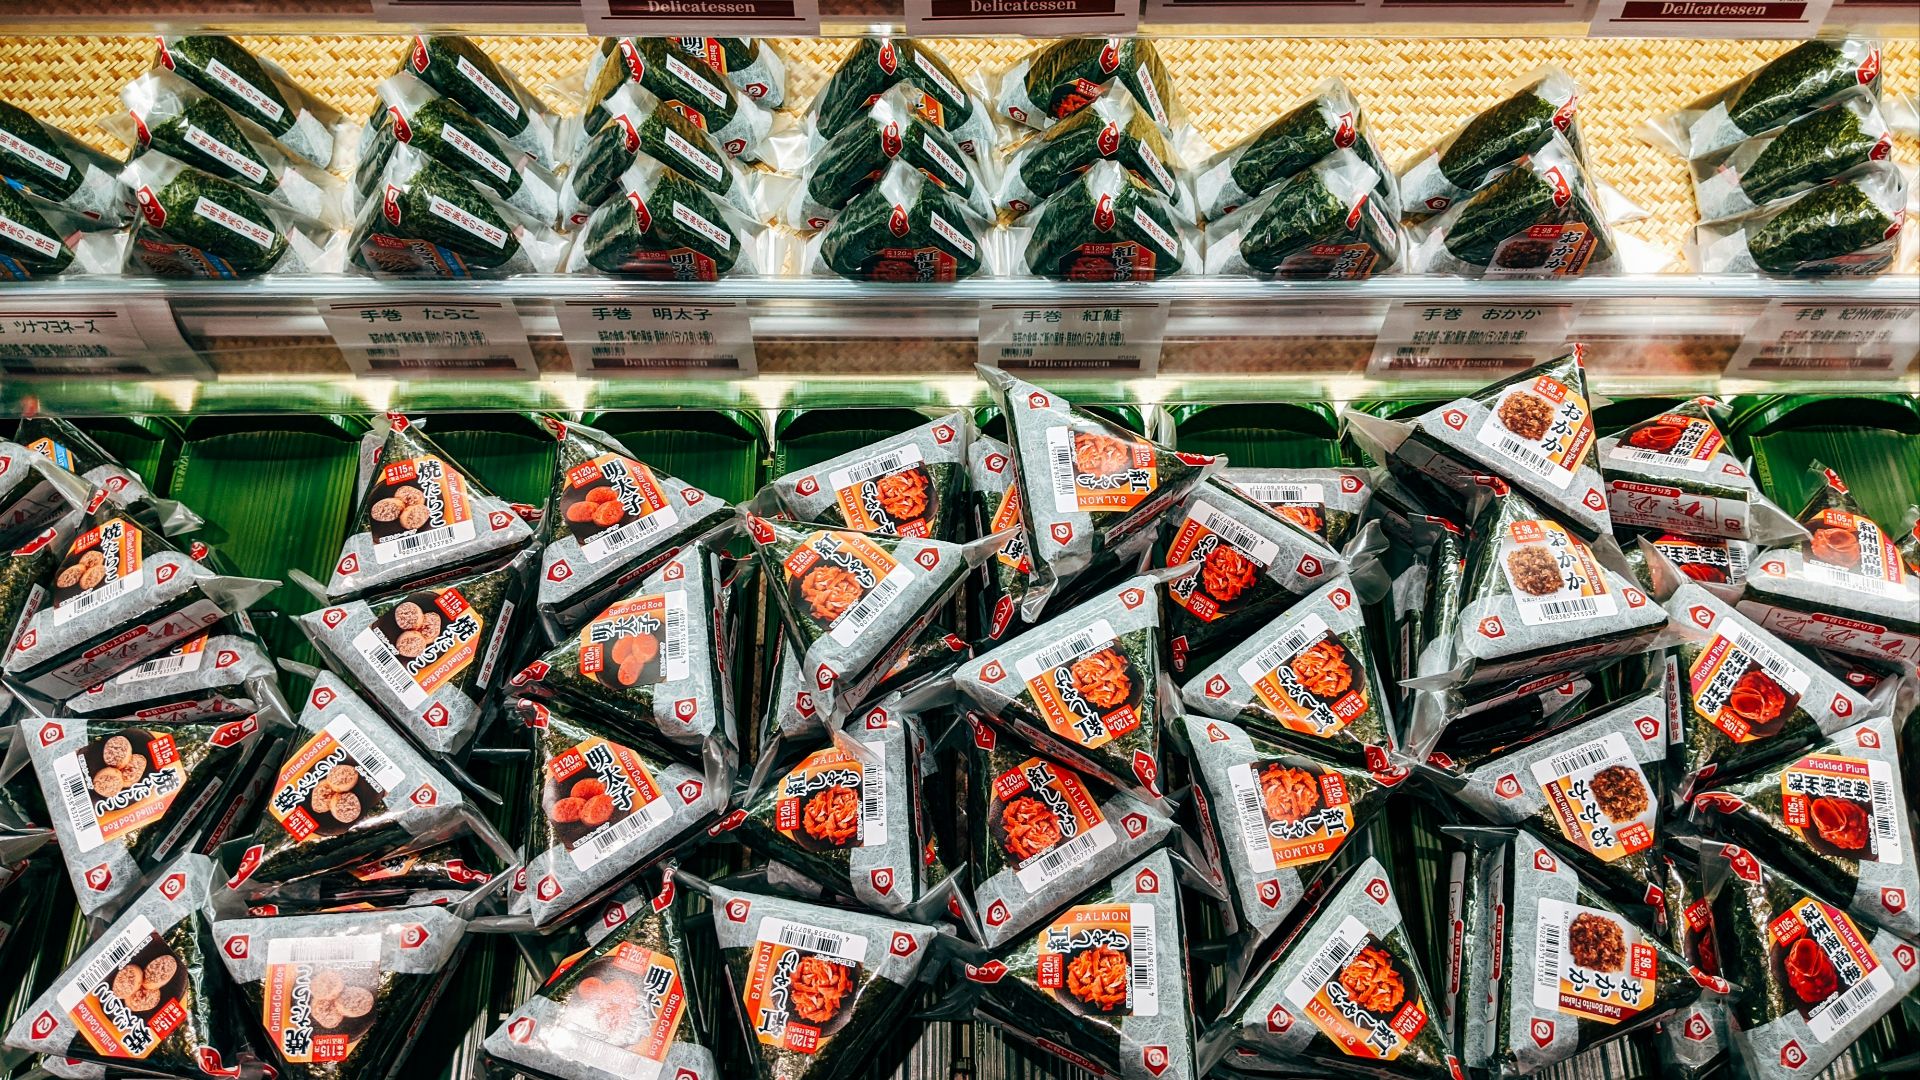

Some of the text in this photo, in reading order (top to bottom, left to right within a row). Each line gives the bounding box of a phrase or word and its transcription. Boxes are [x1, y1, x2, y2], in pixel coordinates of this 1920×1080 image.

[647, 0, 756, 13] Delicatessen
[970, 0, 1077, 12] Delicatessen
[1660, 2, 1767, 15] Delicatessen
[1544, 231, 1584, 269] おかか
[15, 319, 100, 334] ツナマヨネーズ
[360, 307, 480, 322] 手巻 たらこ
[592, 307, 713, 321] 手巻 明太子
[1023, 308, 1123, 323] 手巻 紅鮭
[1422, 307, 1541, 321] 手巻 おかか
[1795, 308, 1914, 321] 手巻 紀州南高梅
[1541, 400, 1584, 455] おかか
[1670, 421, 1710, 458] 紀州南高梅
[417, 461, 446, 527] 焼たらこ
[601, 458, 645, 515] 明太子
[1076, 468, 1151, 493] 紅しゃけ
[1079, 495, 1127, 505] SALMON
[101, 523, 123, 583] 焼たらこ
[814, 533, 876, 588] 紅しゃけ
[850, 533, 894, 573] SALMON
[1171, 521, 1201, 565] SALMON
[1546, 529, 1587, 590] おかか
[1859, 520, 1882, 578] 紀州南高梅
[408, 615, 478, 675] 焼たらこ
[590, 612, 660, 643] 明太子
[1032, 678, 1066, 726] SALMON
[1055, 667, 1105, 743] 紅しゃけ
[1256, 679, 1297, 729] SALMON
[1277, 667, 1334, 733] 紅しゃけ
[1697, 649, 1749, 714] 紀州南高梅
[95, 768, 181, 817] 焼たらこ
[273, 748, 345, 813] 焼たらこ
[585, 743, 633, 811] 明太子
[786, 769, 861, 796] 紅しゃけ
[1027, 762, 1077, 837] 紅しゃけ
[1788, 774, 1871, 801] 紀州南高梅
[1064, 777, 1099, 826] SALMON
[1269, 808, 1347, 837] 紅しゃけ
[1569, 779, 1612, 847] おかか
[1275, 843, 1325, 860] SALMON
[1046, 926, 1128, 952] 紅しゃけ
[1075, 911, 1129, 920] SALMON
[1799, 901, 1861, 984] 紀州南高梅
[750, 944, 772, 1002] SALMON
[759, 950, 799, 1035] 紅しゃけ
[1569, 967, 1641, 1005] おかか
[95, 983, 152, 1054] 焼たらこ
[285, 965, 312, 1056] 焼たらこ
[1309, 1000, 1356, 1048] SALMON
[1328, 981, 1396, 1056] 紅しゃけ
